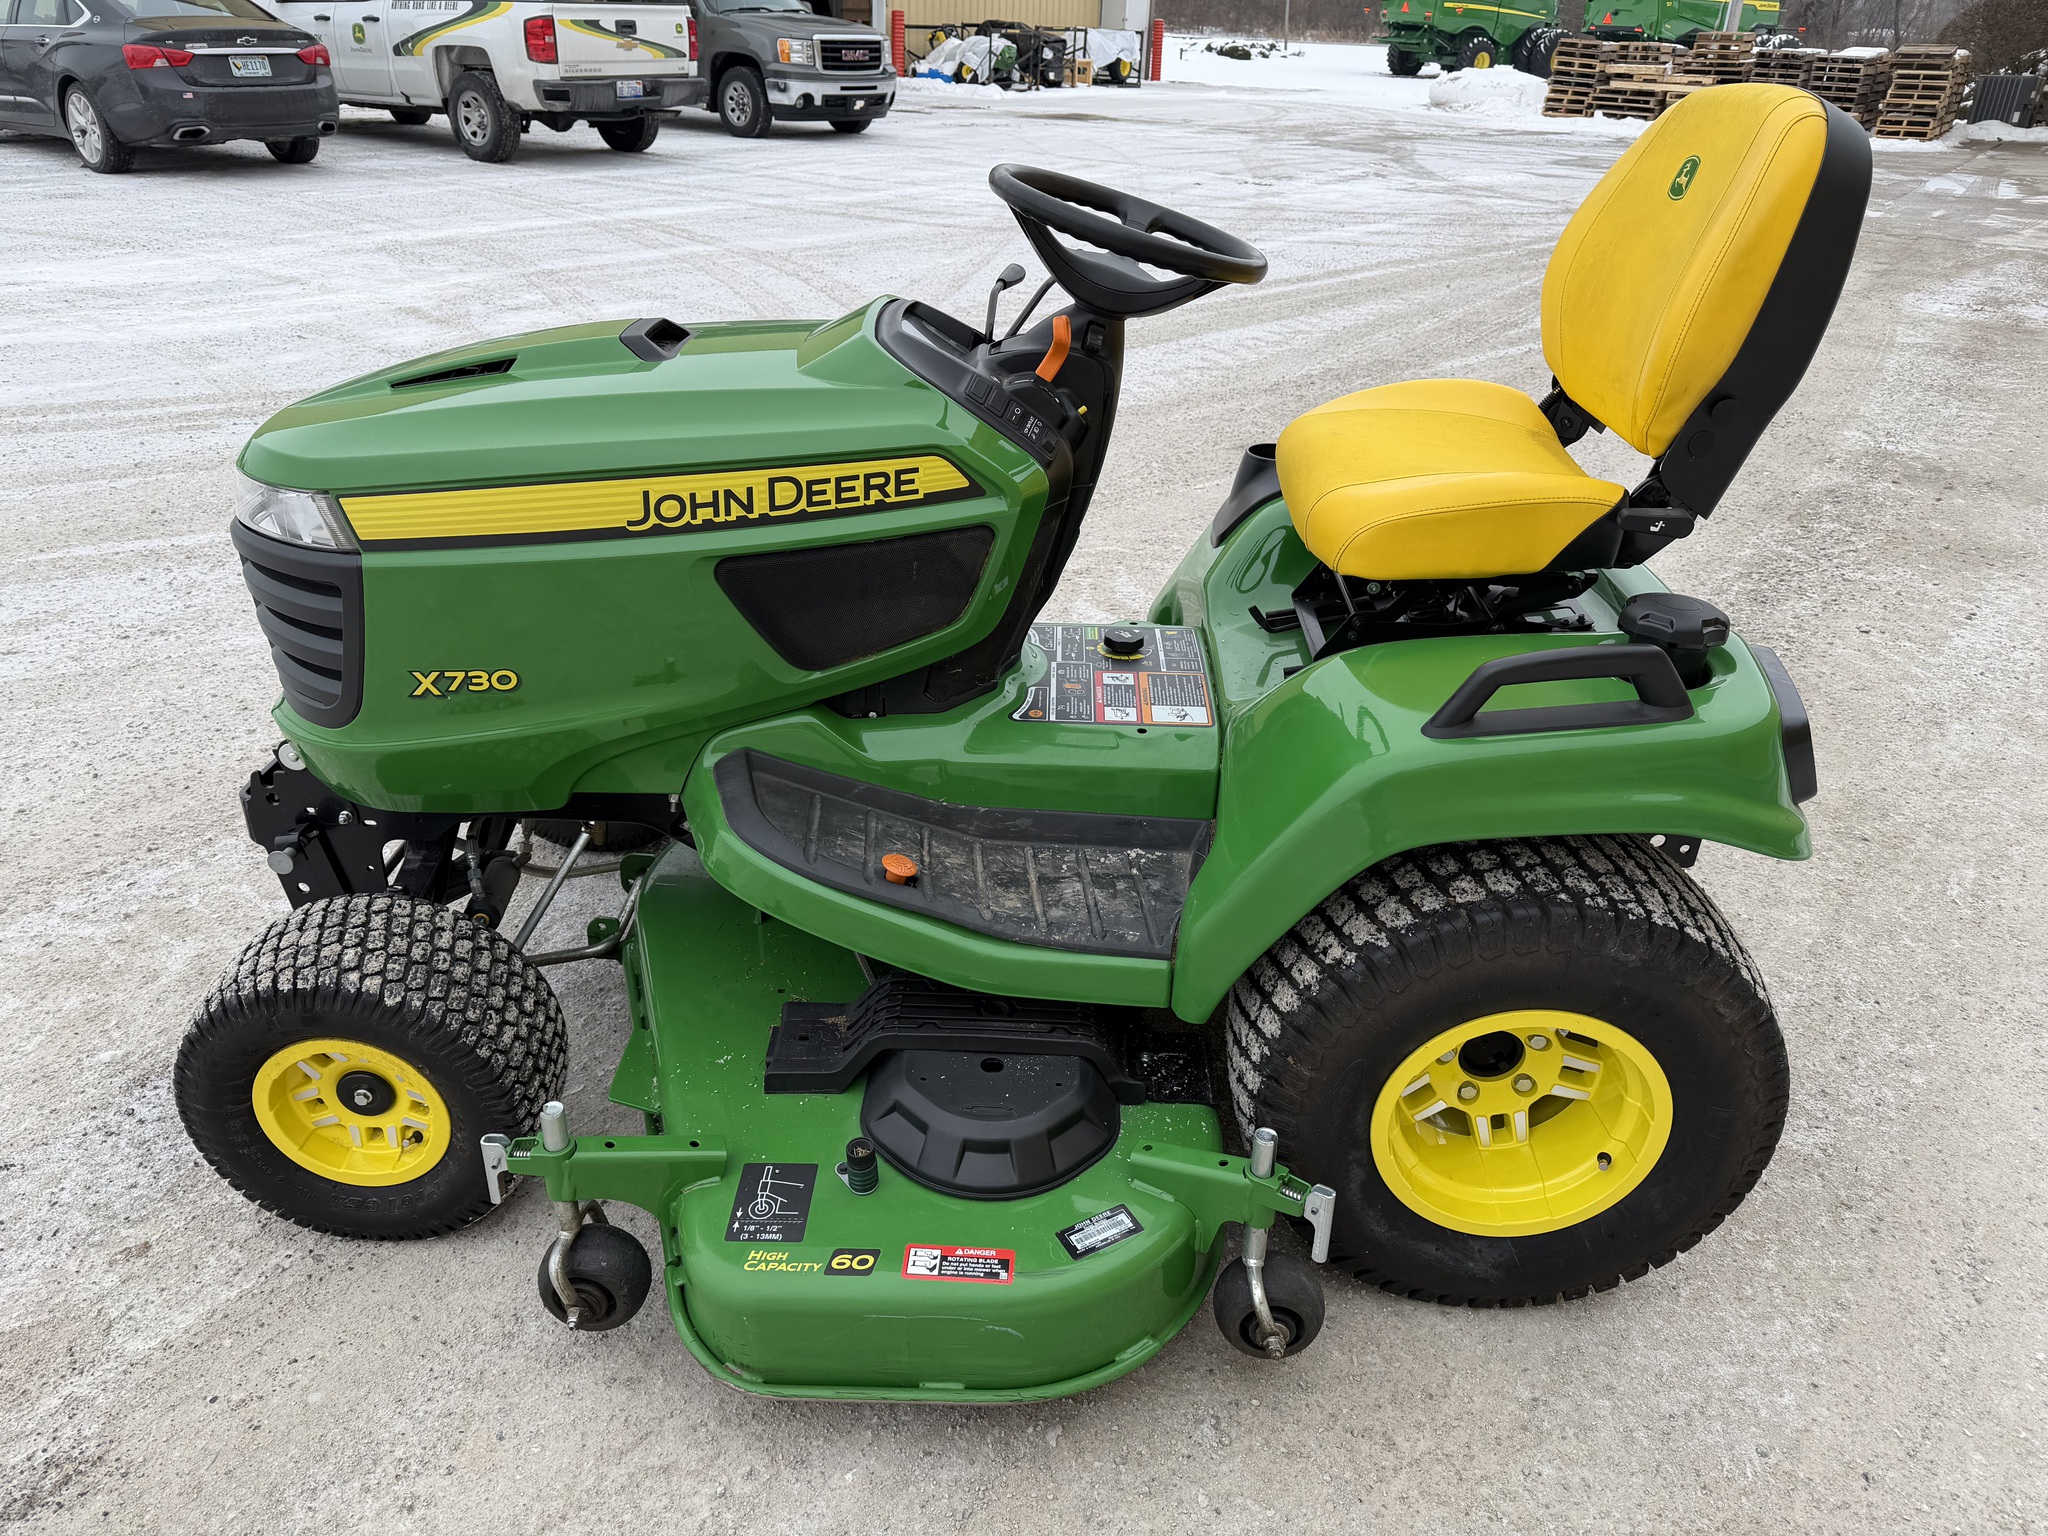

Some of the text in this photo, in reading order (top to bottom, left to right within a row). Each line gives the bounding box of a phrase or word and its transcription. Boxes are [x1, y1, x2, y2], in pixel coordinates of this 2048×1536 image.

[412, 1, 425, 10] RUNS
[426, 1, 437, 10] LIKE
[444, 1, 459, 11] DEERE
[842, 49, 869, 61] GMC
[625, 466, 921, 529] JOHN DEERE
[408, 669, 520, 697] X730
[1074, 1210, 1111, 1229] JOHN DEERE
[740, 1233, 748, 1241] (3
[756, 1233, 782, 1241] 13MM)
[747, 1250, 789, 1261] HIGH
[963, 1249, 996, 1257] DANGER
[743, 1260, 824, 1272] CAPACITY
[830, 1254, 875, 1270] 60
